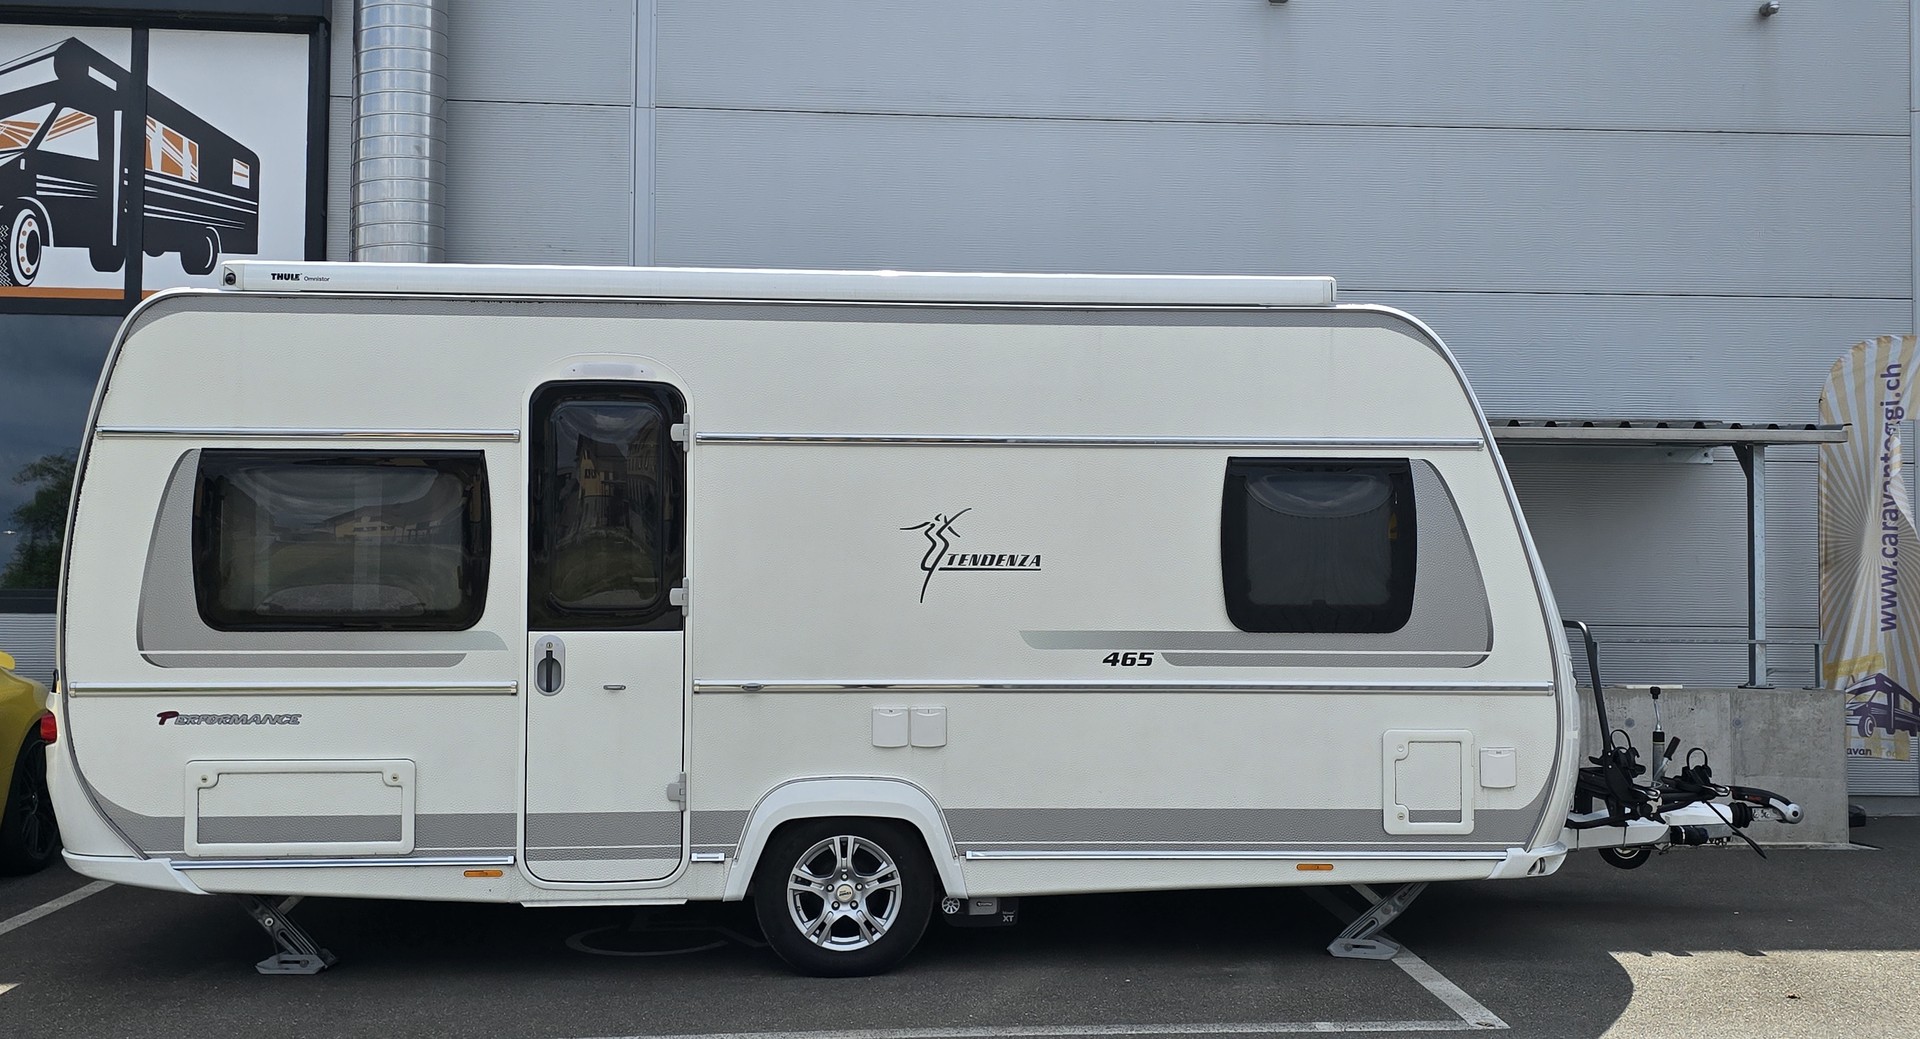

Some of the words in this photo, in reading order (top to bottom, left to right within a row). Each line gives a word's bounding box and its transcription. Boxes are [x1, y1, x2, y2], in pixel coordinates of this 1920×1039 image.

[271, 272, 300, 281] THULE
[946, 553, 1042, 567] TENDENZA
[1102, 652, 1155, 667] 465
